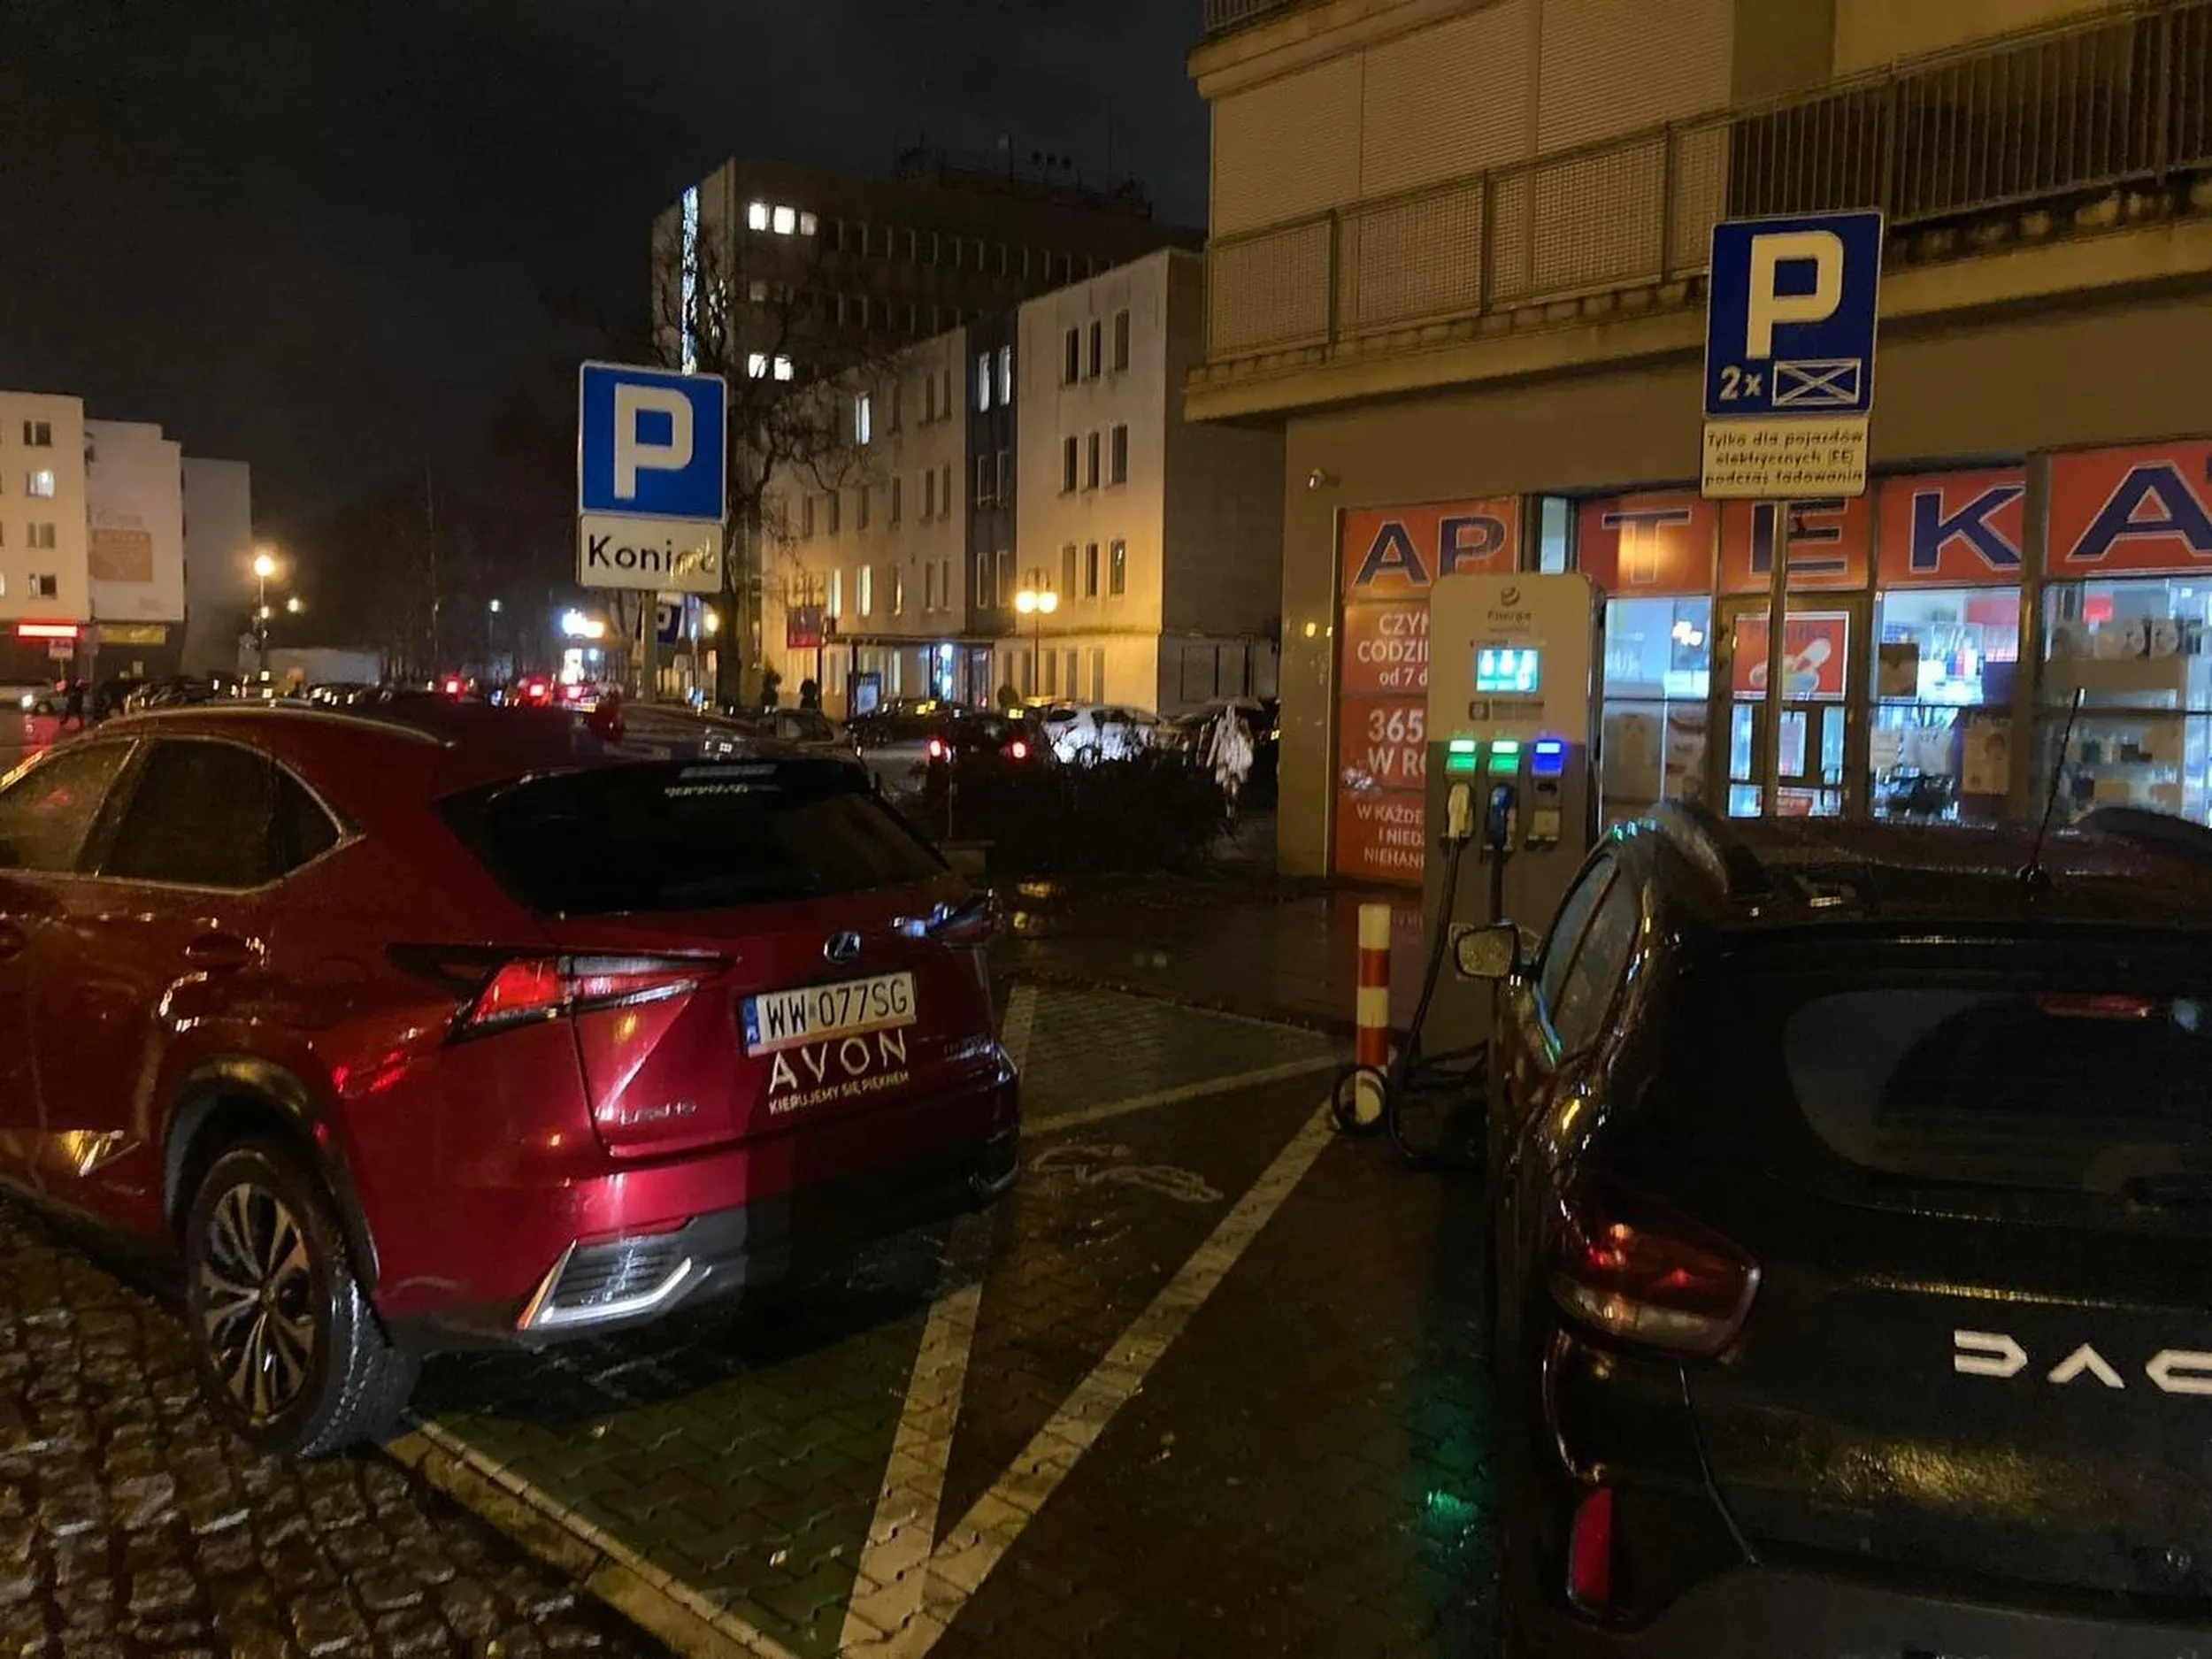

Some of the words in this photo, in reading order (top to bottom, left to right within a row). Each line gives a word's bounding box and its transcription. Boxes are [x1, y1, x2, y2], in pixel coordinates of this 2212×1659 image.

[1747, 230, 1844, 359] P
[1719, 365, 1763, 400] 2x
[614, 382, 694, 500] P
[1708, 433, 1746, 449] Tylko
[1753, 431, 1778, 446] dla
[1379, 668, 1399, 687] od
[1404, 669, 1413, 687] 7
[1368, 709, 1424, 743] 365
[1368, 748, 1394, 775] W
[1356, 803, 1371, 819] W
[1363, 847, 1424, 871] NIEHAN
[766, 995, 806, 1038] WW
[818, 979, 907, 1027] 077SG
[769, 1029, 906, 1094] AVON
